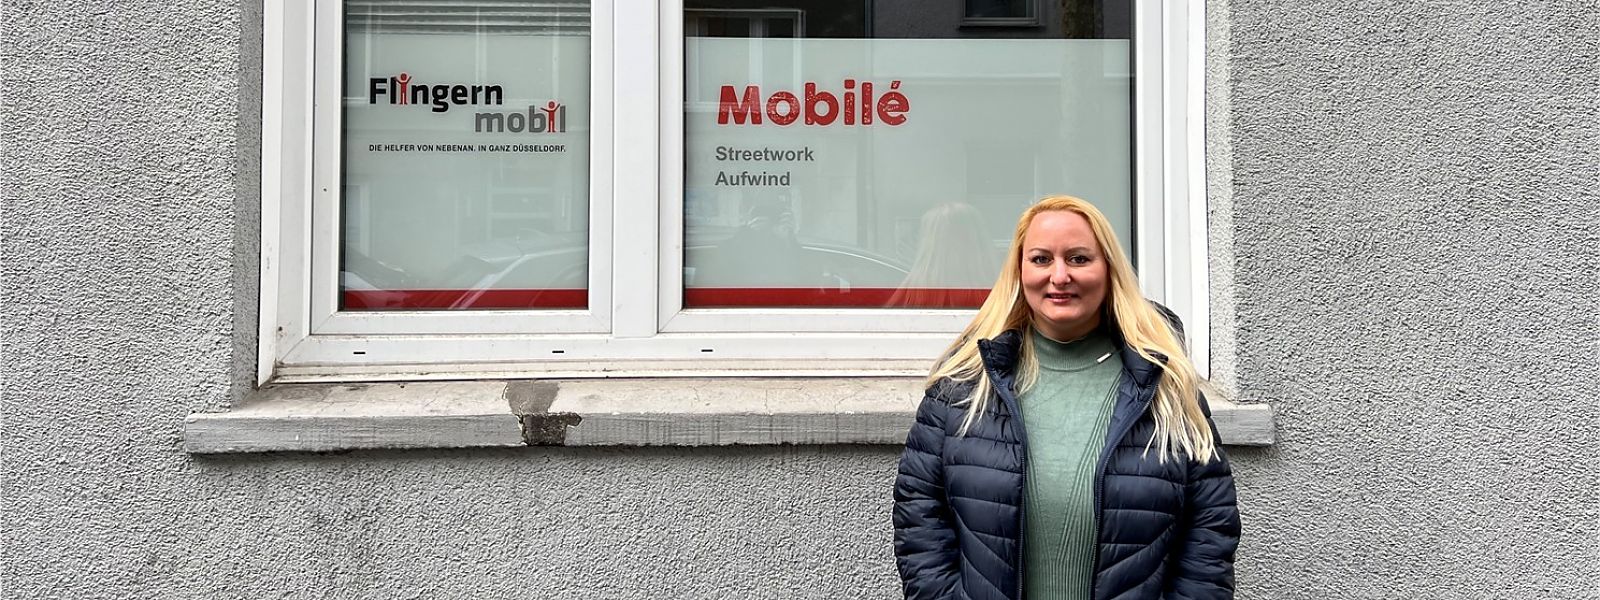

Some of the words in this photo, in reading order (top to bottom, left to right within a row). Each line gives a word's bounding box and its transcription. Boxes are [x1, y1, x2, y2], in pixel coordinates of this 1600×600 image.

[369, 73, 503, 113] Flingern
[717, 79, 910, 126] Mobilé
[475, 101, 566, 133] mobil
[369, 144, 382, 152] DIE
[384, 144, 415, 152] HELFER
[417, 144, 433, 152] VON
[435, 144, 476, 152] NEBENAN.
[478, 144, 487, 152] IN
[488, 144, 511, 153] GANZ
[512, 143, 566, 153] DÜSSELDORF.
[715, 146, 815, 161] Streetwork
[714, 171, 791, 186] Aufwind
